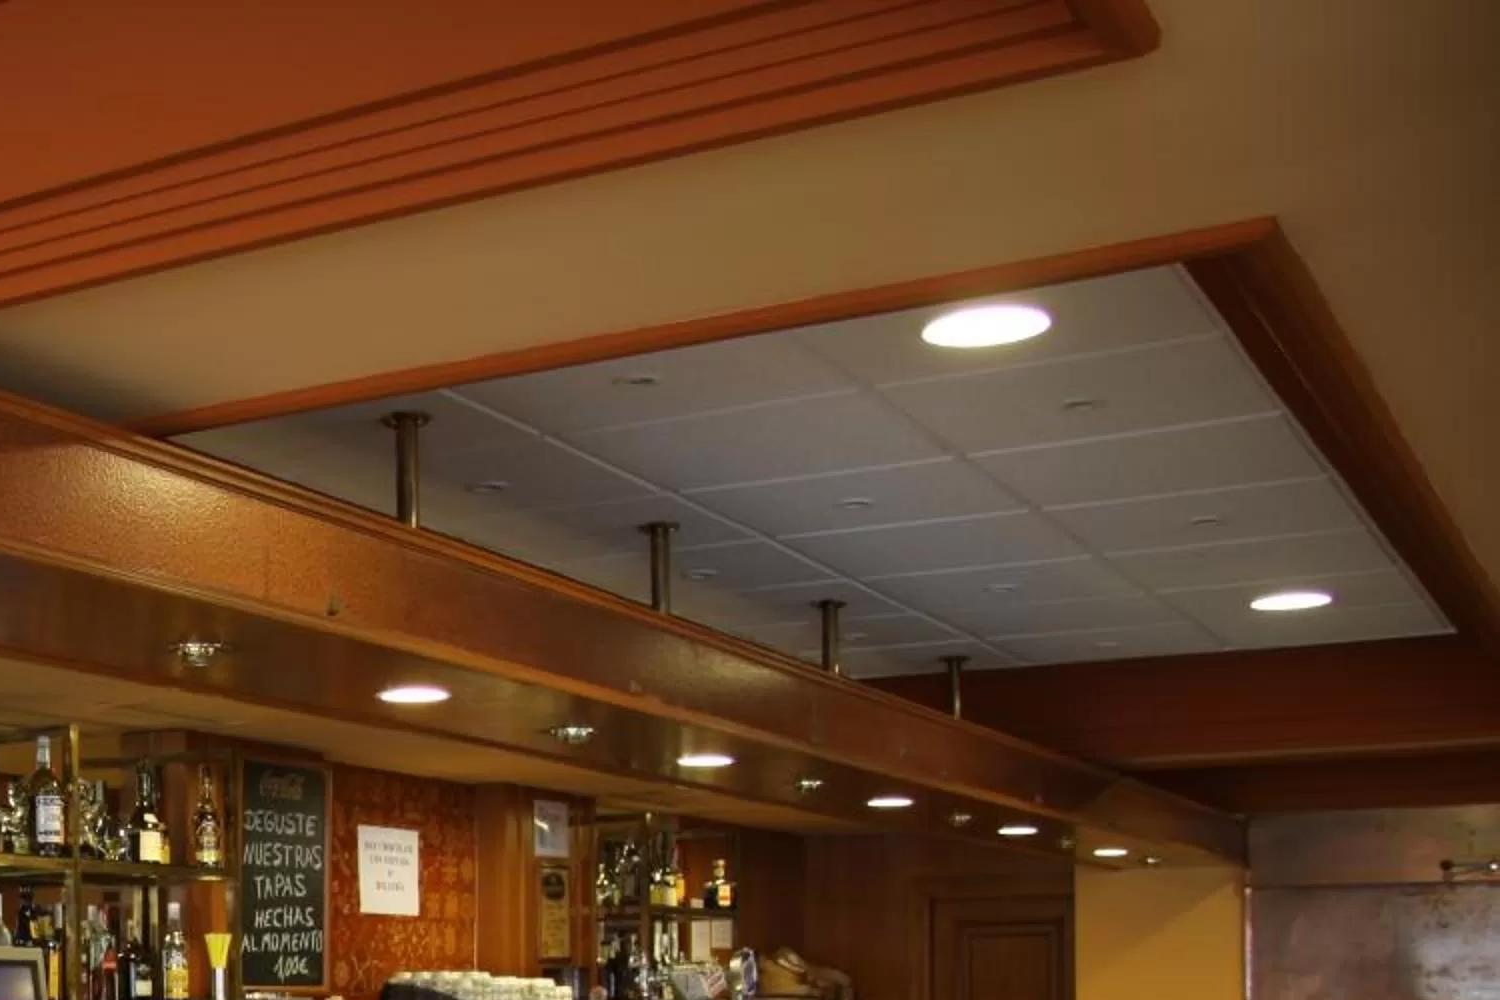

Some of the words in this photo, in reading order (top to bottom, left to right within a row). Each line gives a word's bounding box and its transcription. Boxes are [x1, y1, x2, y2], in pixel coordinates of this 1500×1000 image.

[243, 841, 323, 870] NUESTRAS
[254, 873, 307, 899] TAPAS
[254, 904, 315, 929] HECHAS
[241, 933, 259, 953] AL
[261, 929, 323, 953] MOMENTO
